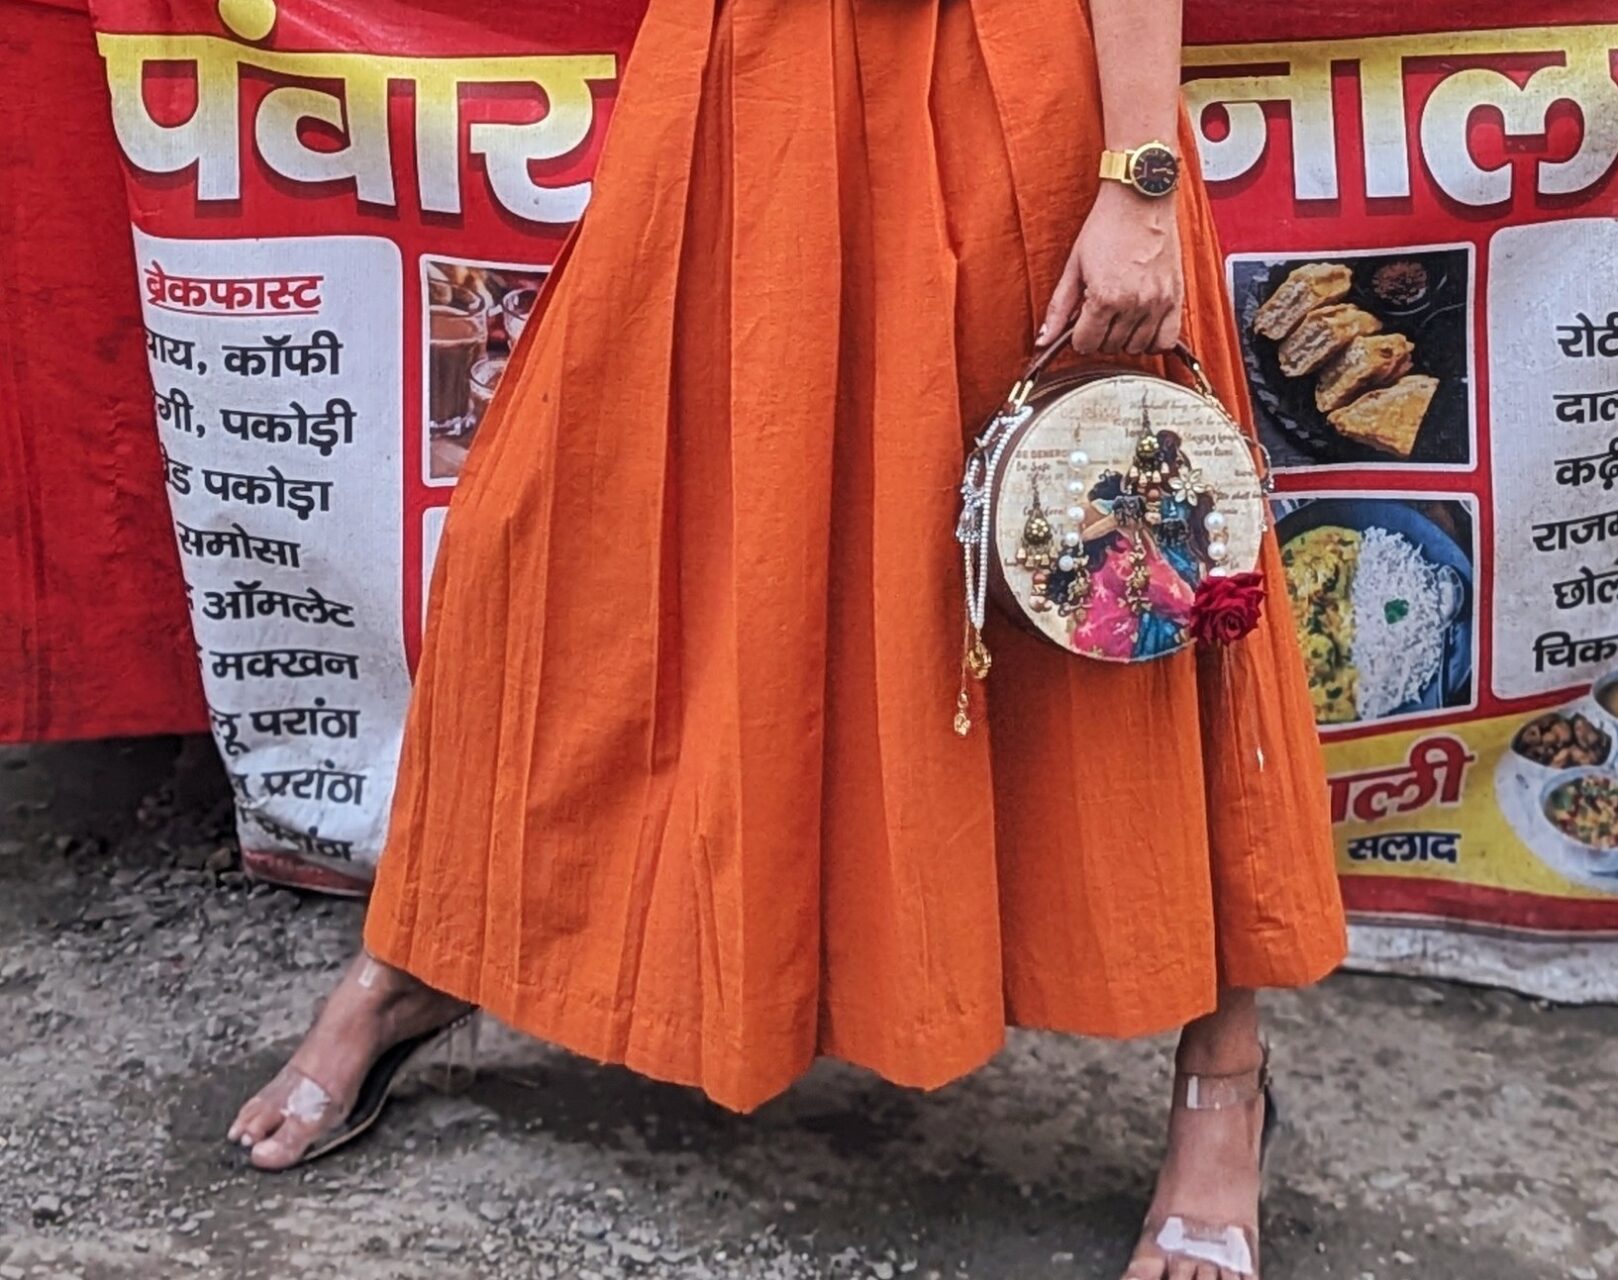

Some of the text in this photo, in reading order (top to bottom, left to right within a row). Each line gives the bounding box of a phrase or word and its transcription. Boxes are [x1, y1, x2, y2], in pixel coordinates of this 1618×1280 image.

[1181, 24, 1618, 207] नाल
[145, 260, 324, 310] ब्रेकफास्ट
[221, 330, 343, 377] कॉफी
[154, 387, 357, 457] गी, पकोड़ी
[202, 465, 334, 521] पकोड़ा
[176, 520, 301, 569] समोसा
[202, 580, 355, 628] ऑमलेट
[1553, 558, 1618, 609] छोल
[208, 649, 359, 681] मक्खन
[1532, 631, 1618, 673] चिक
[249, 697, 361, 739] परांठा
[262, 759, 367, 805] परांठा
[1329, 736, 1476, 825] ाली
[1347, 831, 1462, 864] सलाद
